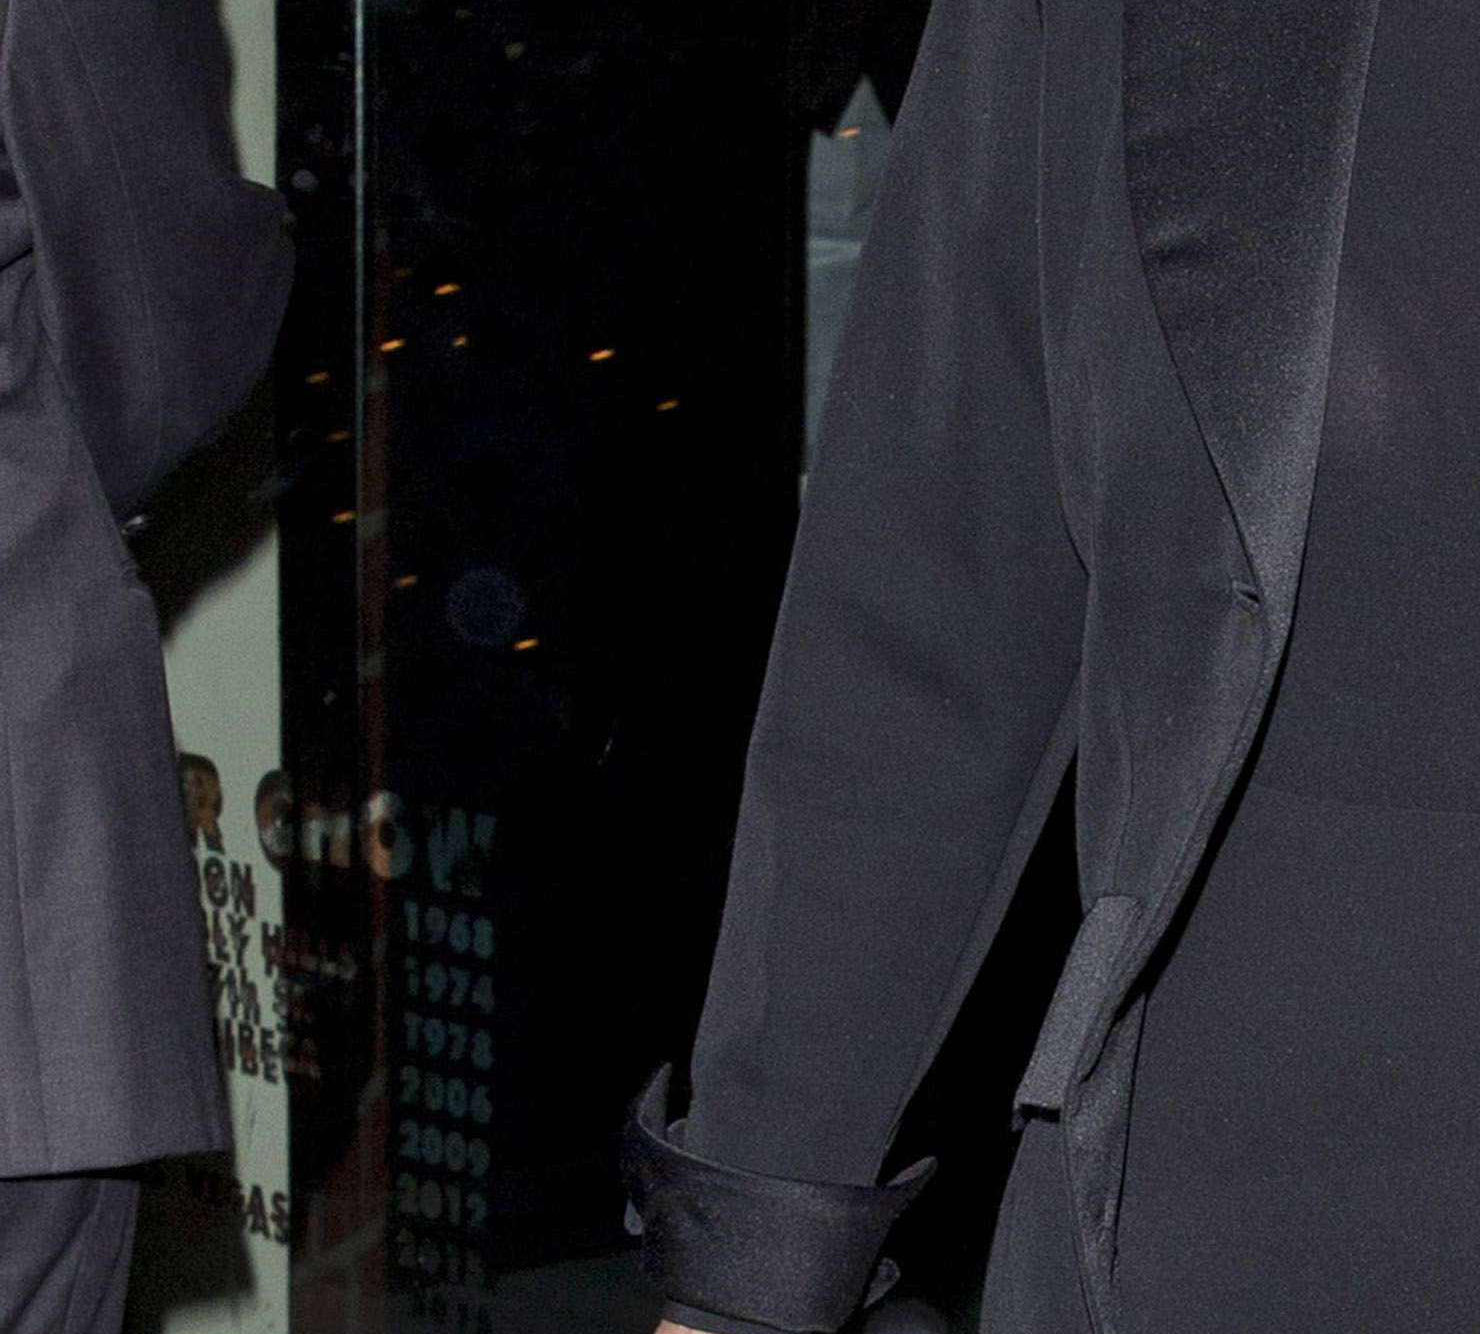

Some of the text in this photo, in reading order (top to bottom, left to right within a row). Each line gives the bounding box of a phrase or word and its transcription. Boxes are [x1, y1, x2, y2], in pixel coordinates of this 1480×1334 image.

[403, 900, 495, 959] 1968
[404, 956, 495, 1015] 1974
[403, 1011, 495, 1070] 1978
[400, 1065, 492, 1124] 2006
[399, 1119, 491, 1177] 2009
